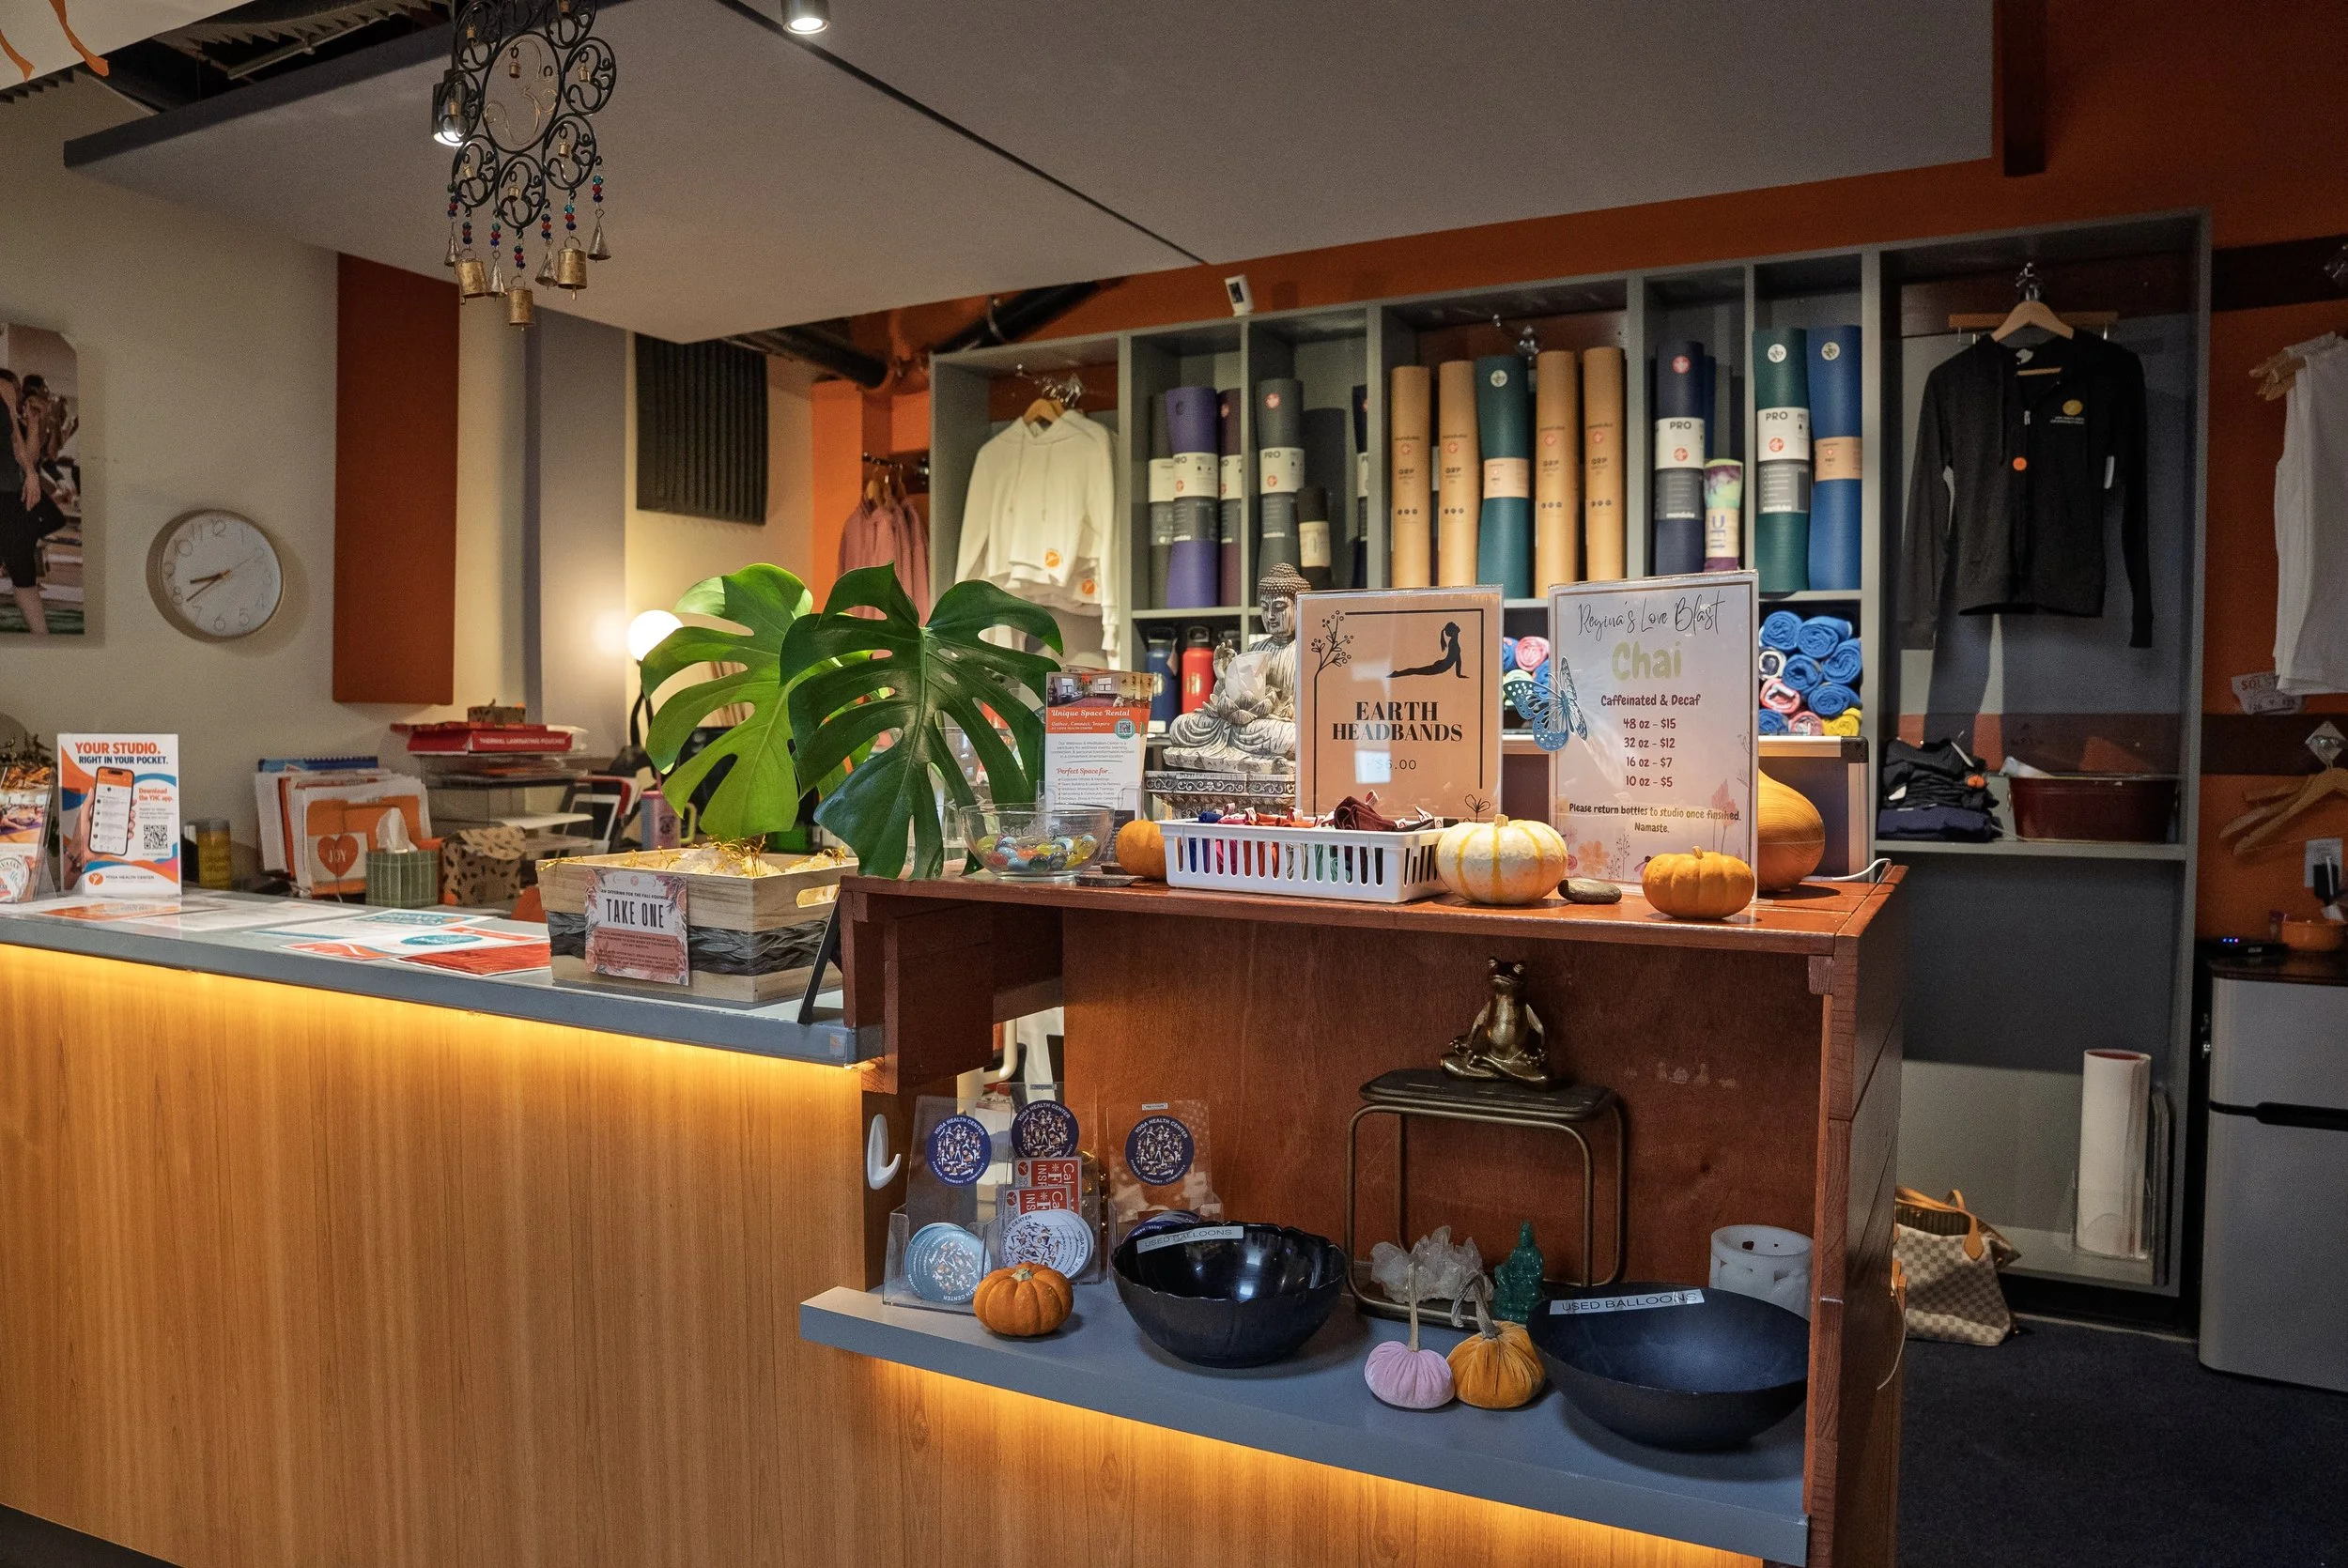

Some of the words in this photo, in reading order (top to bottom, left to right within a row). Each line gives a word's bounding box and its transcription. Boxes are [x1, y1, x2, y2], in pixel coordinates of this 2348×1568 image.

[1766, 411, 1788, 421] PRO
[1669, 421, 1691, 430] PRO
[1578, 600, 1636, 642] Regina's
[1641, 598, 1668, 633] Love
[1674, 590, 1726, 636] Blast
[1612, 640, 1682, 681] Chai
[1600, 694, 1657, 707] Caffeinated
[1660, 695, 1668, 706] &
[1671, 694, 1701, 706] Decaf
[1051, 709, 1079, 718] Unique
[1080, 709, 1104, 718] Space
[1354, 700, 1439, 721] EARTH
[1623, 718, 1636, 730] 48
[1639, 720, 1650, 730] oz
[1661, 718, 1676, 730] $15
[1332, 723, 1463, 742] HEADBANDS
[75, 742, 110, 755] YOUR
[113, 742, 162, 755] STUDIO.
[1623, 737, 1636, 748] 32
[1638, 740, 1649, 748] oz
[1660, 737, 1676, 748] $12
[78, 755, 102, 764] RIGHT
[104, 756, 114, 764] IN
[114, 756, 135, 764] YOUR
[136, 756, 169, 765] POCKET.
[1626, 757, 1636, 767] 16
[1638, 759, 1650, 768] oz
[1660, 757, 1673, 768] $7
[1056, 767, 1079, 776] Perfect
[1079, 768, 1098, 776] Space
[1626, 776, 1637, 787] 10
[1638, 778, 1650, 787] oz
[1661, 776, 1673, 787] $5
[1568, 804, 1592, 813] Please
[1593, 806, 1619, 815] return
[1620, 806, 1648, 816] bottles
[1649, 807, 1658, 816] to
[1660, 807, 1684, 818] studio
[1686, 810, 1705, 819] once
[1634, 822, 1670, 834] Namaste.
[328, 848, 348, 864] JOY
[606, 899, 635, 925] TAKE
[641, 902, 664, 929] ONE
[1017, 1109, 1030, 1121] YOGA
[1029, 1102, 1051, 1111] HEALTH
[1051, 1103, 1071, 1119] CENTER
[935, 1122, 947, 1134] YOGA
[946, 1116, 966, 1125] HEALTH
[966, 1117, 985, 1136] CENTER
[1135, 1121, 1149, 1133] YOGA
[1170, 1121, 1188, 1139] CENTER
[1012, 1215, 1032, 1227] CENTER
[1145, 1237, 1170, 1247] USED
[1172, 1229, 1233, 1242] BALLOONS
[1562, 1300, 1600, 1312] USED
[1605, 1292, 1697, 1309] BALLOONS
